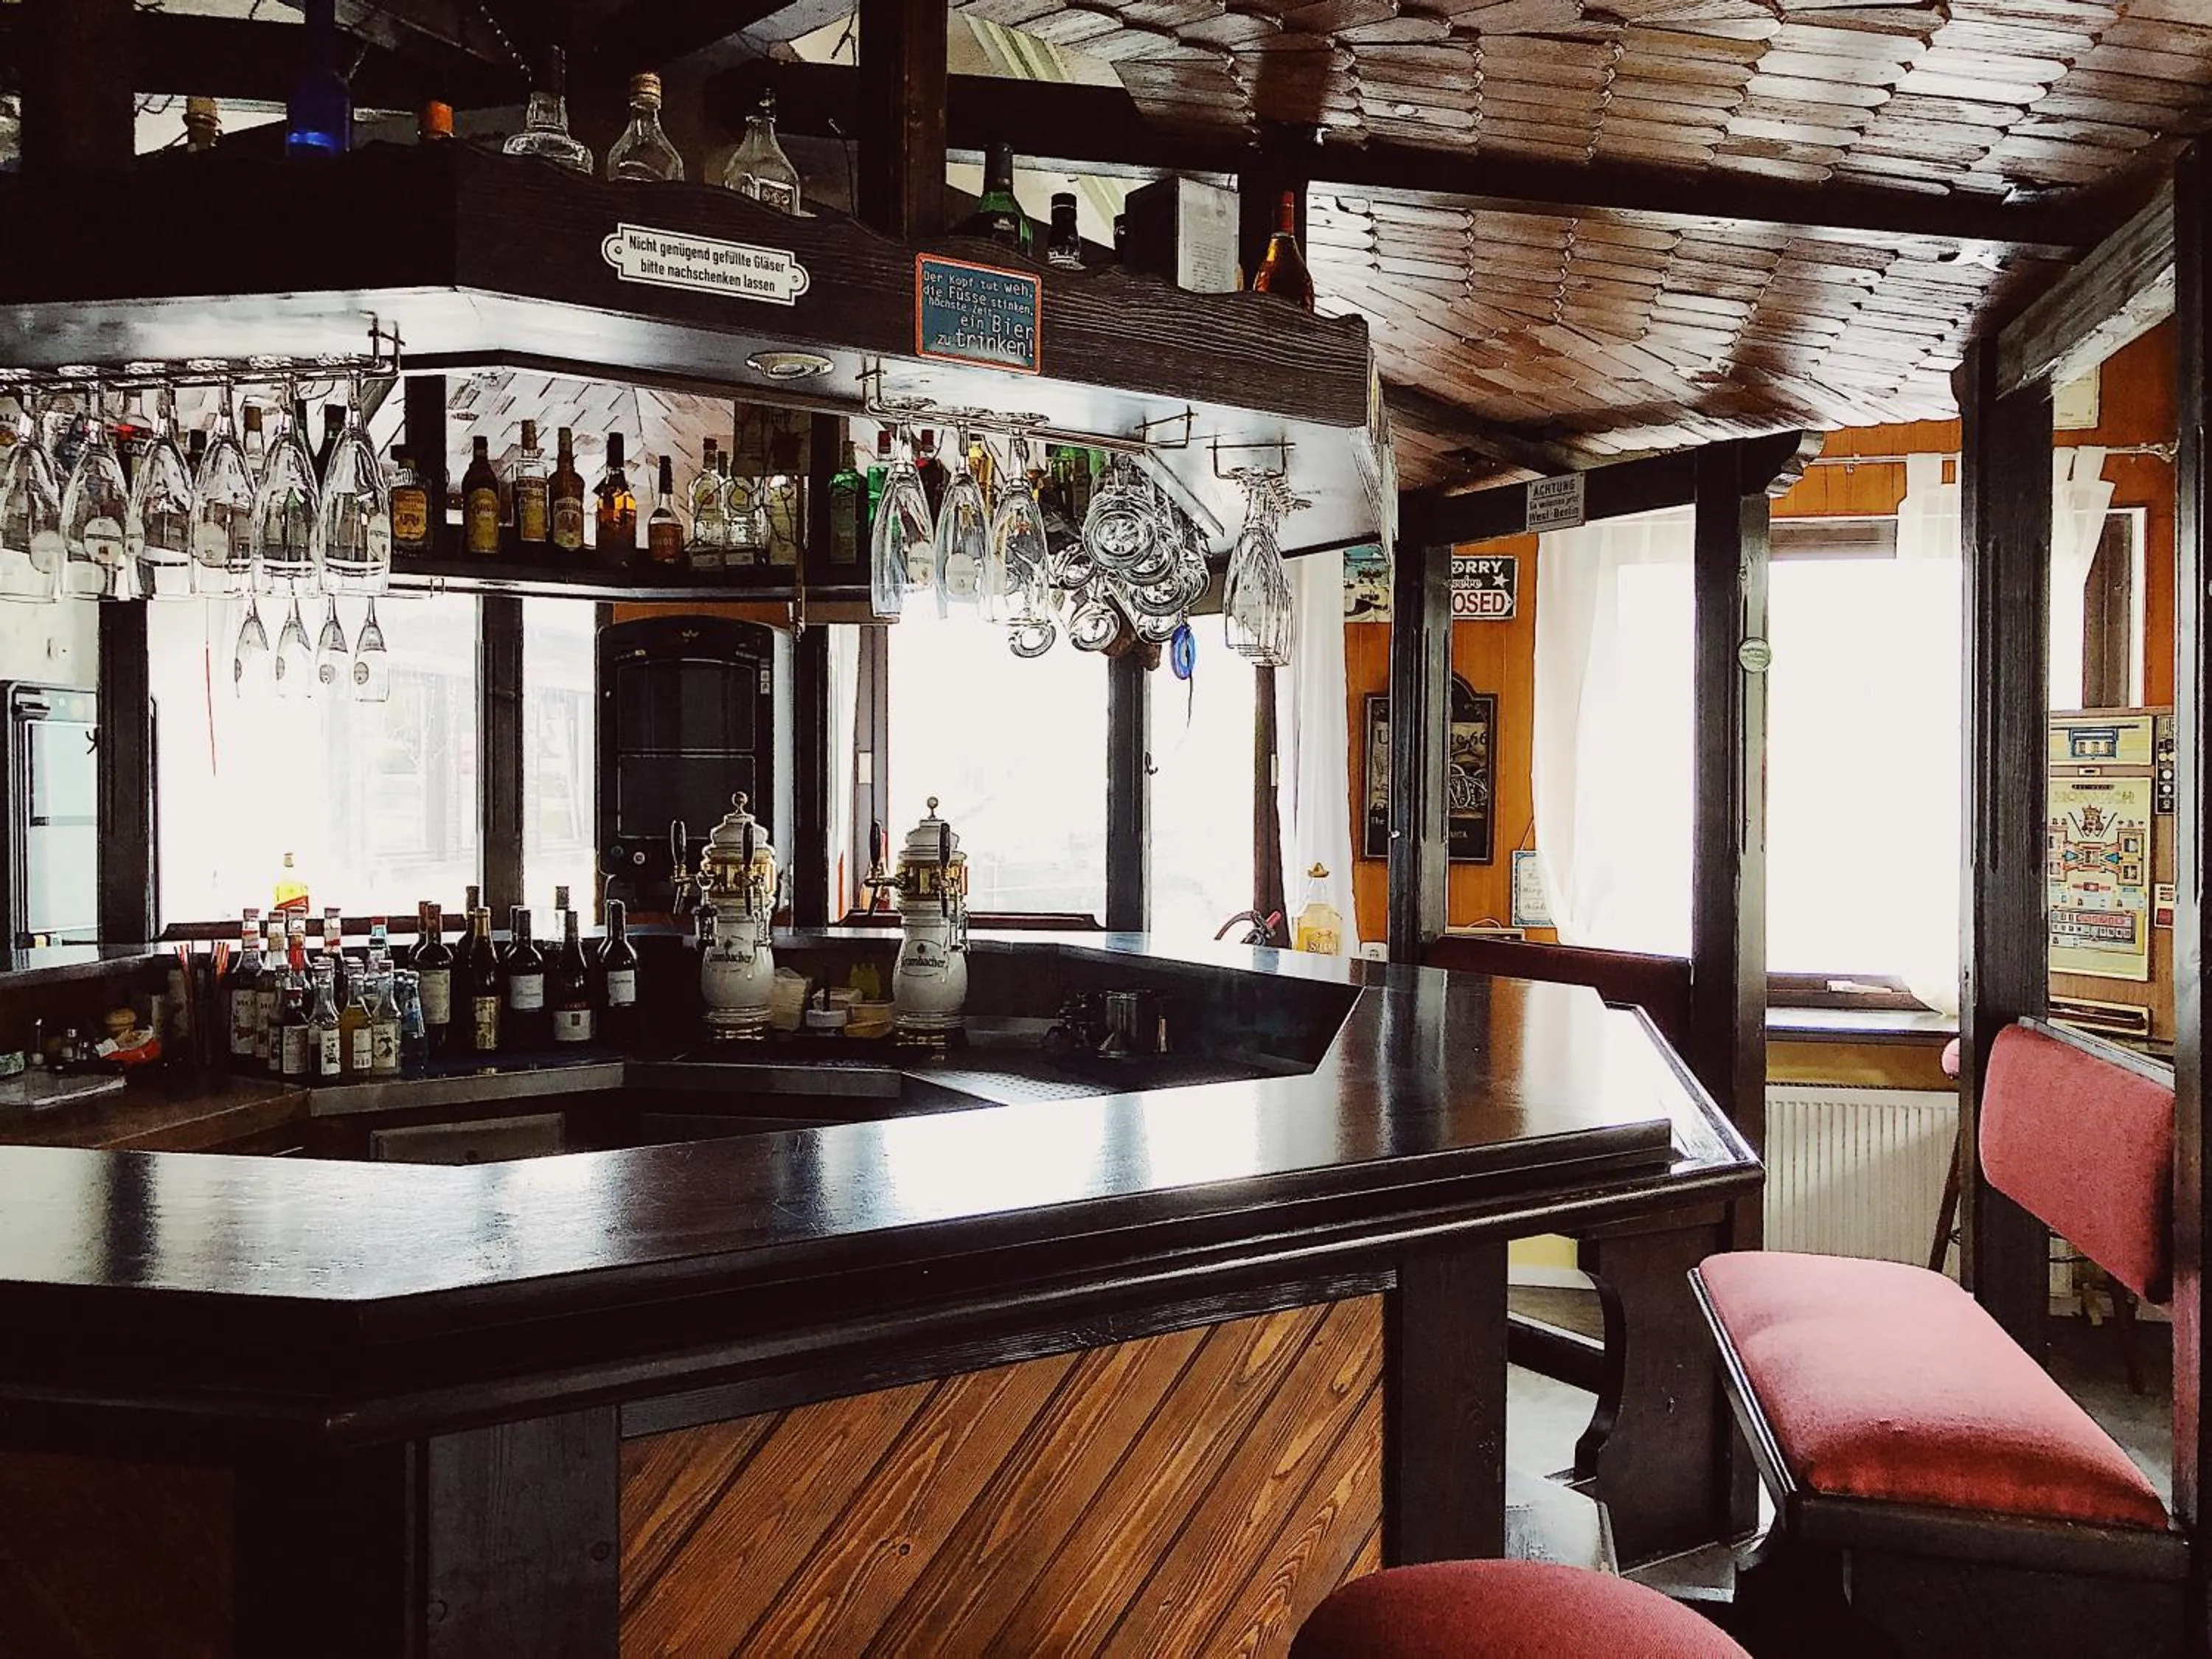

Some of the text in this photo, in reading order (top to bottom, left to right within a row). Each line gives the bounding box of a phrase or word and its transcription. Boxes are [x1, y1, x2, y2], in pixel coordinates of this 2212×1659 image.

[629, 235, 785, 273] Nicht genügend gefüllte Gläser
[641, 259, 775, 292] bitte nachschenken lassen
[924, 271, 943, 282] Der
[949, 275, 973, 286] Kopf
[981, 281, 999, 291] tut
[923, 285, 942, 296] die
[949, 286, 987, 305] Füsse
[928, 296, 967, 311] höchste
[961, 316, 1034, 340] ein Bier
[937, 329, 1033, 358] zu trinken!
[1452, 560, 1503, 574] ORRY
[1453, 592, 1505, 613] OSED
